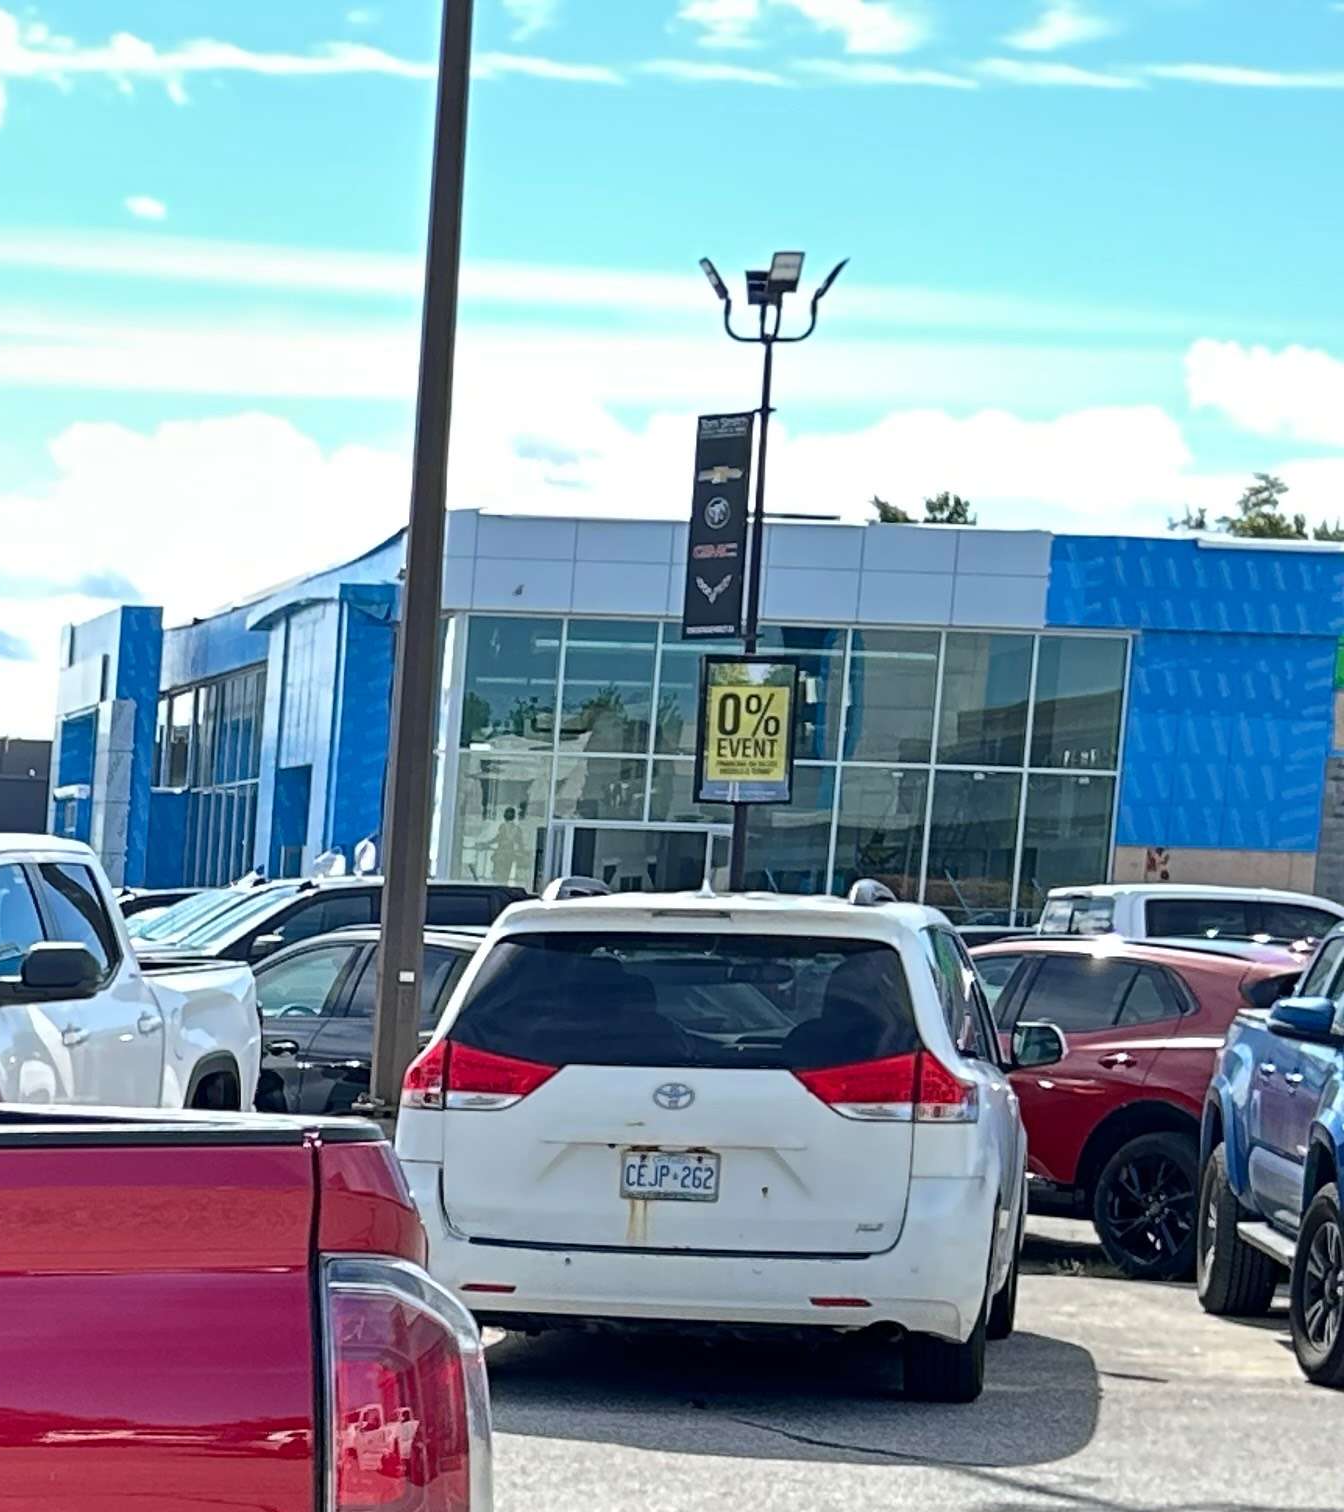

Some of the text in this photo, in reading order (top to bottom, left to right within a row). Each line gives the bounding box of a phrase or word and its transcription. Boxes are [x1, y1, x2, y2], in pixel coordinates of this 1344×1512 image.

[693, 543, 737, 559] GMC
[717, 693, 780, 737] 0%
[716, 738, 778, 759] EVENT
[625, 1164, 714, 1189] CEJP 262
